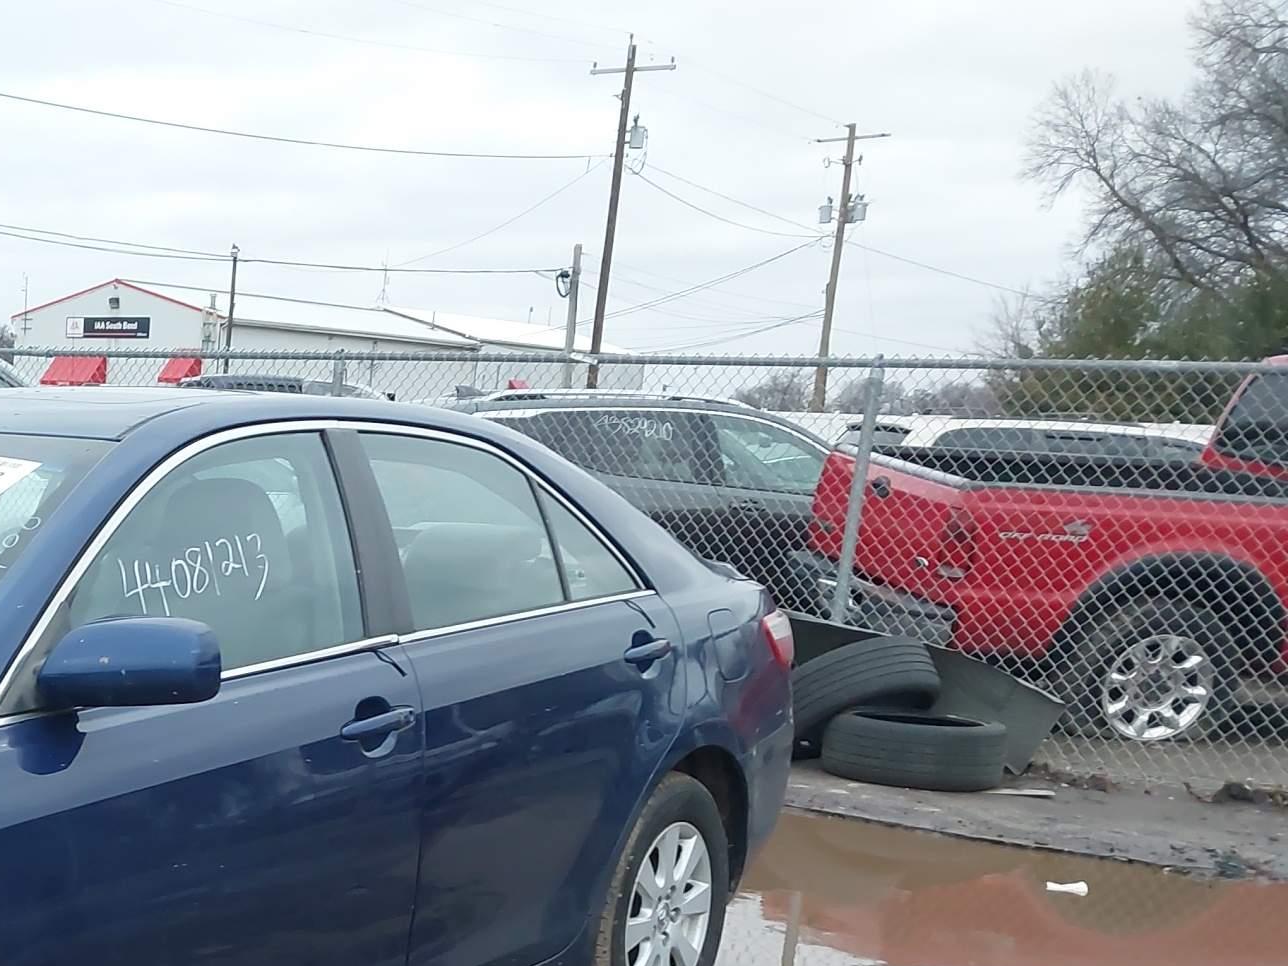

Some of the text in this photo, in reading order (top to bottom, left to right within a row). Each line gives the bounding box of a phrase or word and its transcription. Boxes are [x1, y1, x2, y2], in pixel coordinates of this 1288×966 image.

[94, 321, 138, 330] IAA South Bend
[117, 533, 269, 617] 44081213
